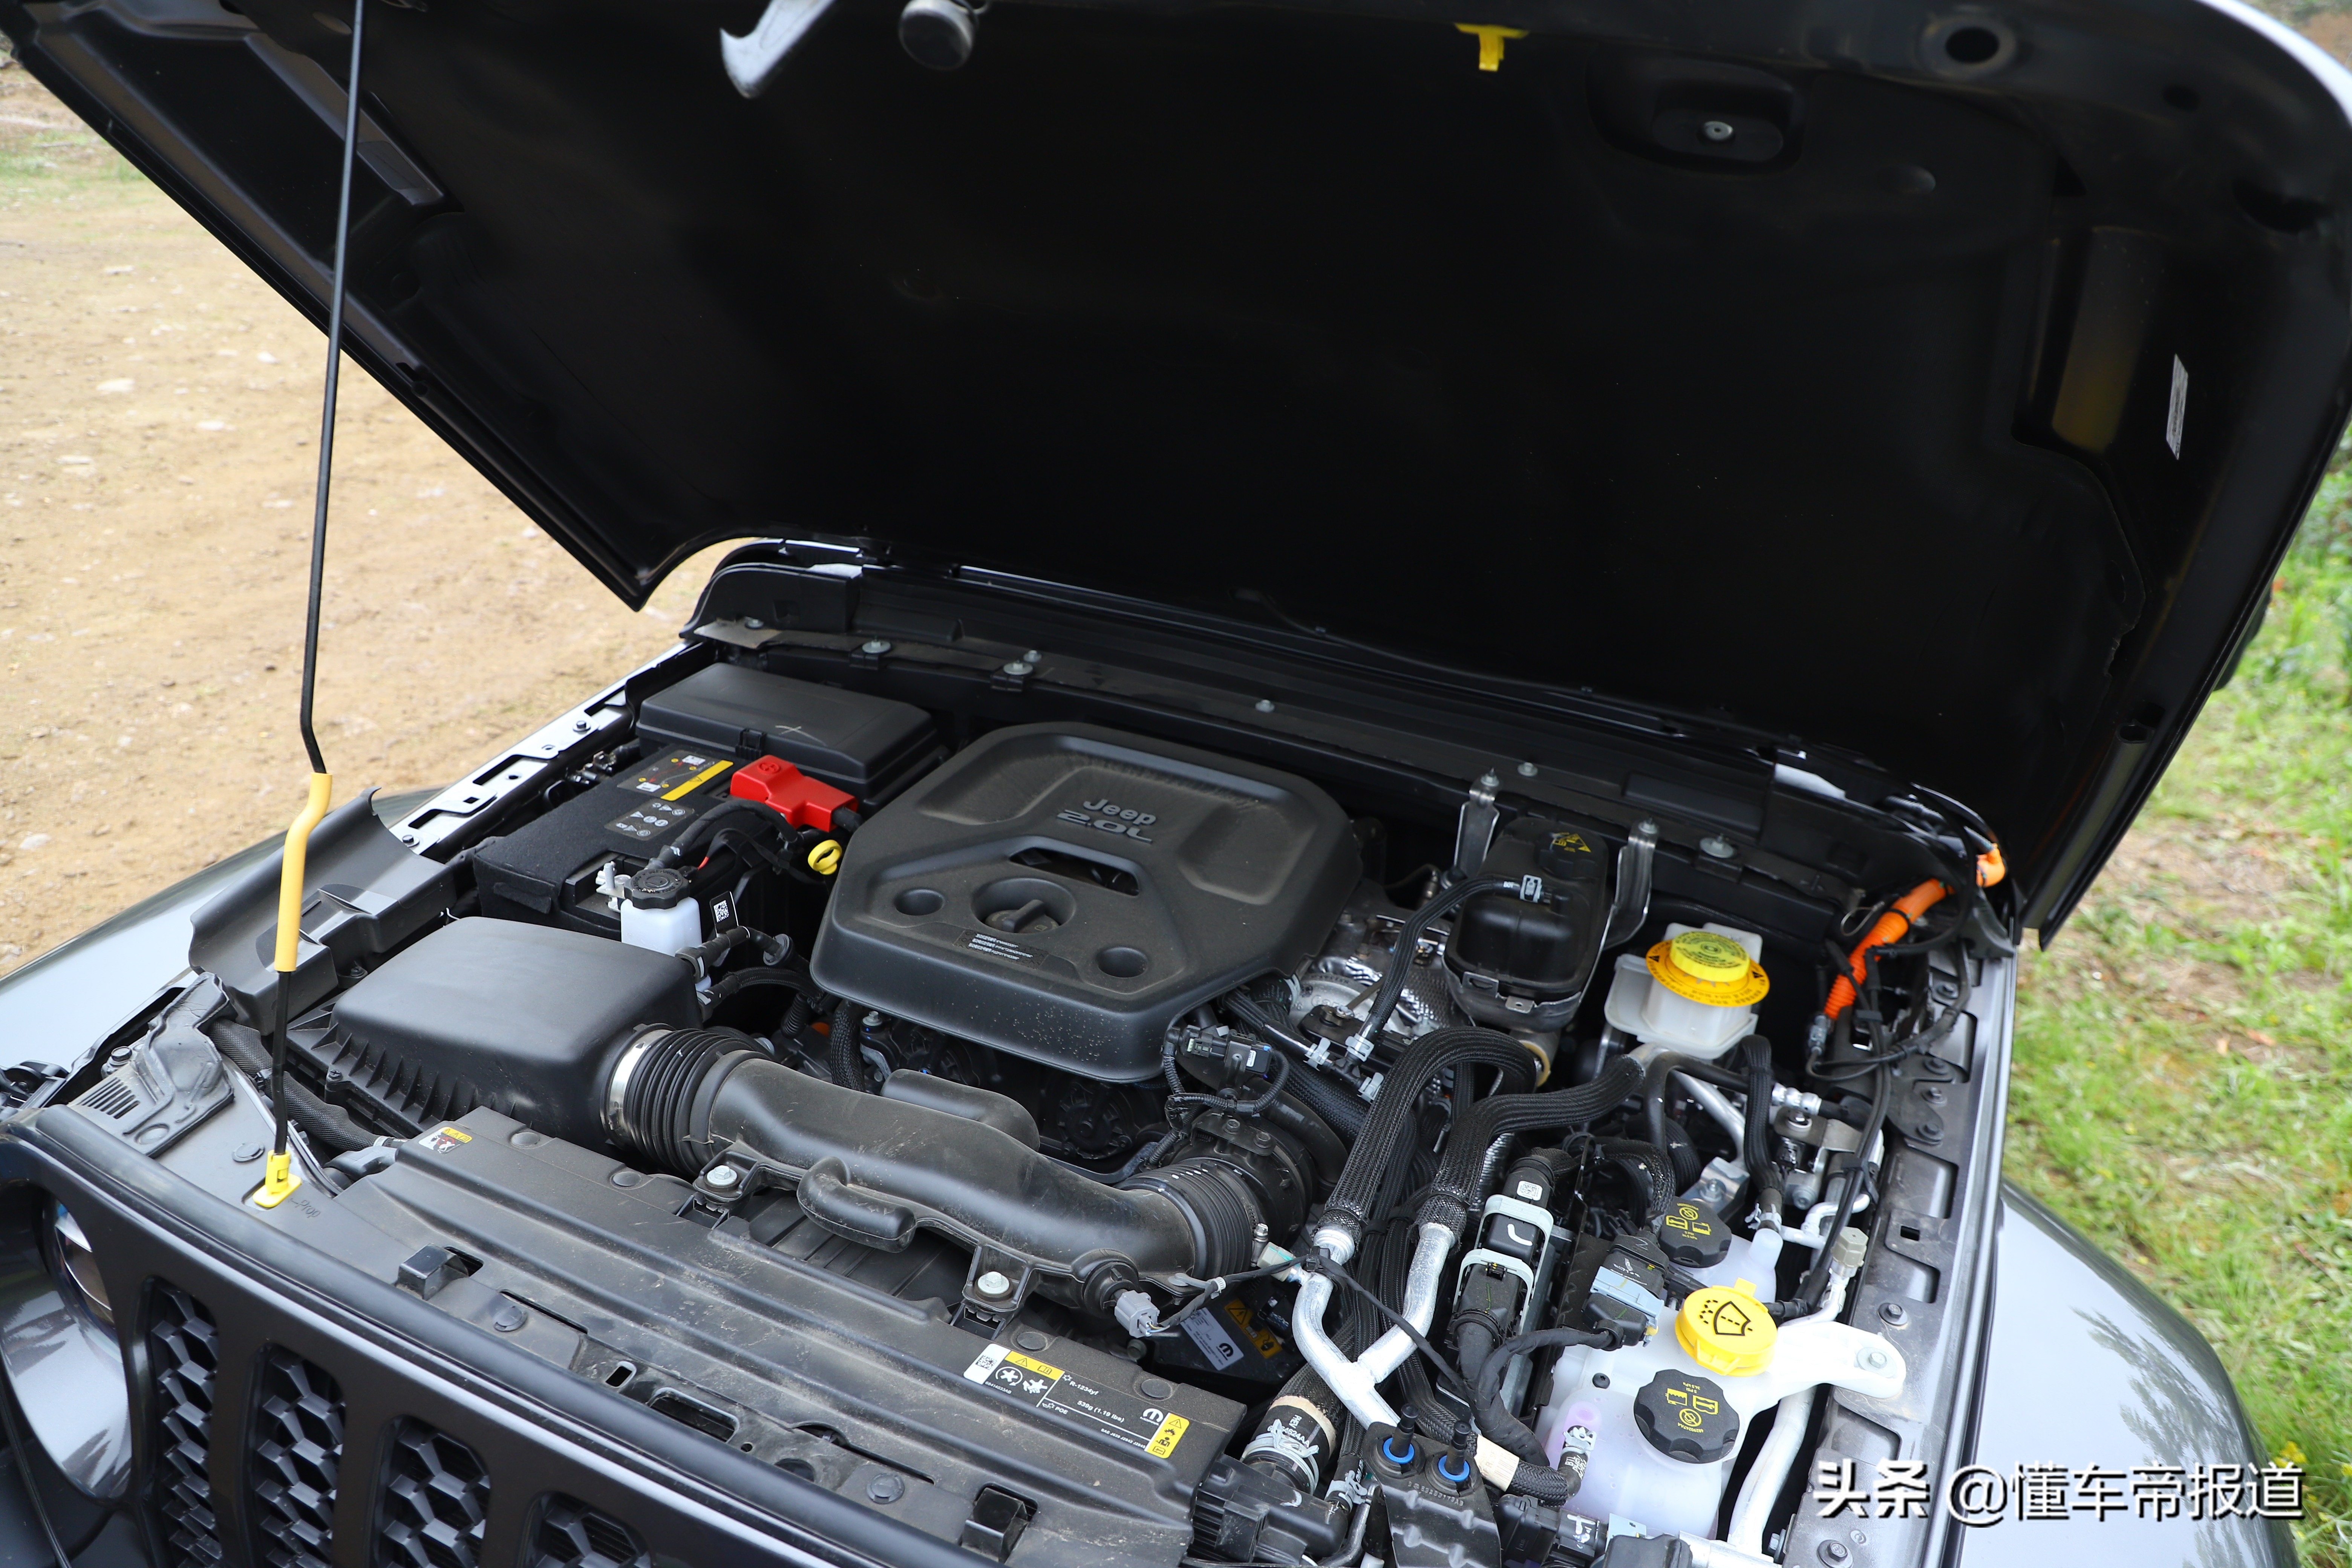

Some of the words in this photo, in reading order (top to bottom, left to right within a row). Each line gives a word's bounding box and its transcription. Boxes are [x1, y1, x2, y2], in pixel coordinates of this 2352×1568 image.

[1083, 799, 1156, 825] Jeep
[1057, 809, 1152, 843] 2.0L
[295, 1200, 321, 1218] Prop
[1069, 1381, 1099, 1395] R-1234yf
[1055, 1406, 1068, 1415] POE
[1077, 1400, 1093, 1411] 539g
[1094, 1407, 1111, 1417] (1.19
[1112, 1413, 1125, 1423] lbs)
[1289, 1414, 1302, 1429] PHEV
[1565, 1456, 1576, 1466] BTL
